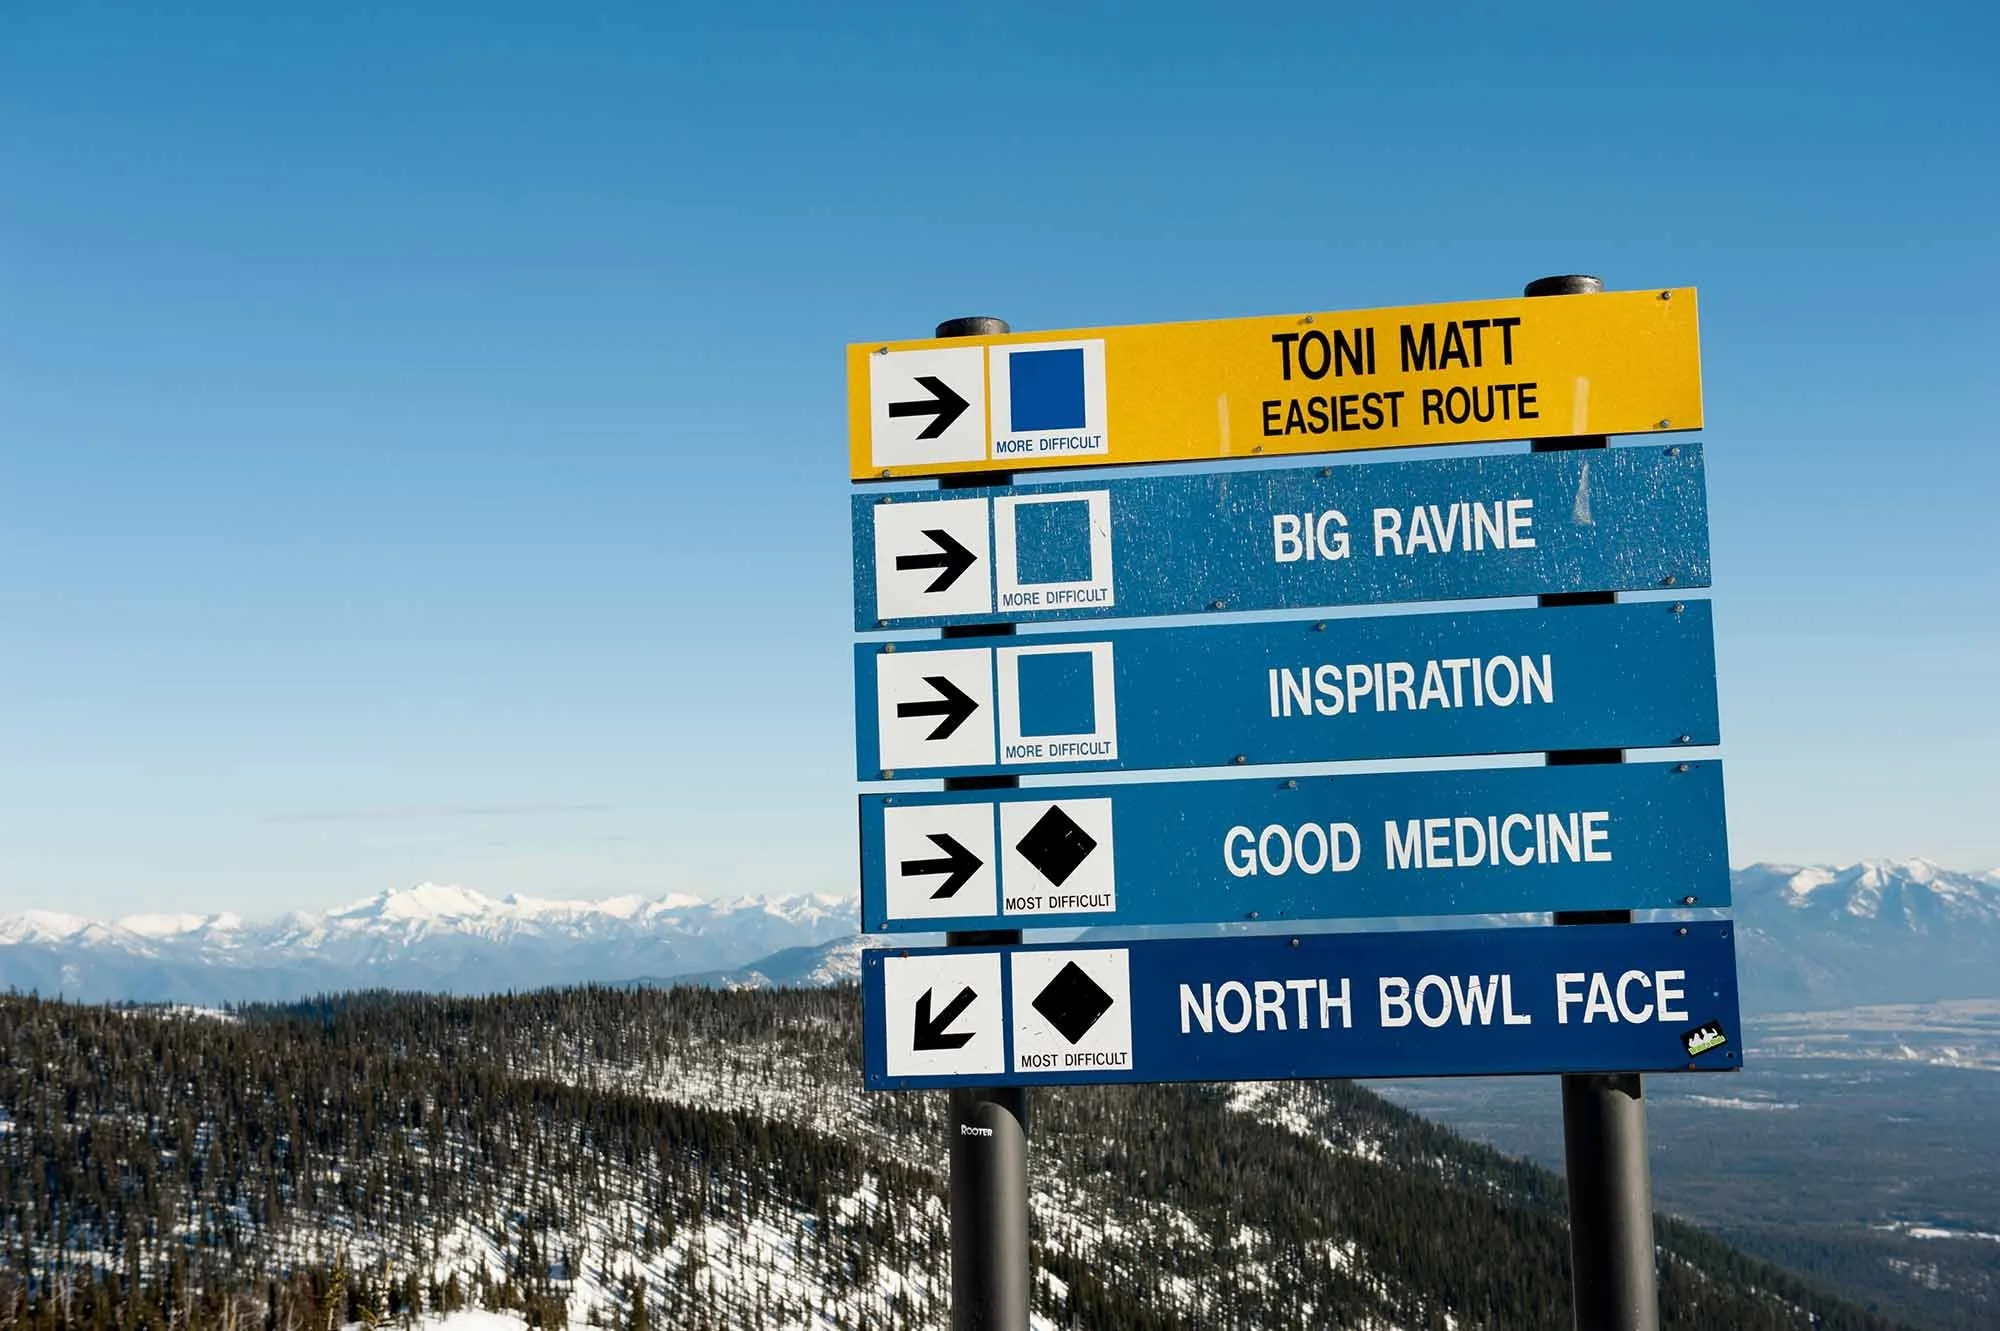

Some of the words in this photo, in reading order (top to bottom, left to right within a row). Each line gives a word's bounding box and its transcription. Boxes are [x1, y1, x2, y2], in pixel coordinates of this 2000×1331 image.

[1272, 328, 1375, 380] TONI
[1400, 317, 1520, 372] MATT
[1263, 391, 1404, 436] EASIEST
[1422, 383, 1538, 425] ROUTE
[997, 440, 1032, 453] MORE
[1040, 436, 1101, 450] DIFFICULT
[1273, 510, 1349, 562] BIG
[1374, 499, 1535, 556] RAVINE
[1003, 592, 1040, 606] MORE
[1047, 589, 1107, 604] DIFFICULT
[1269, 655, 1553, 717] INSPIRATION
[1006, 745, 1043, 758] MORE
[1049, 742, 1111, 756] DIFFICULT
[1224, 823, 1360, 877] GOOD
[1385, 812, 1611, 869] MEDICINE
[1006, 897, 1042, 910] MOST
[1049, 894, 1111, 908] DIFFICULT
[1180, 978, 1352, 1033] NORTH
[1379, 975, 1531, 1027] BOWL
[1556, 970, 1688, 1023] FACE
[1022, 1055, 1058, 1067] MOST
[1065, 1052, 1127, 1066] DIFFICULT
